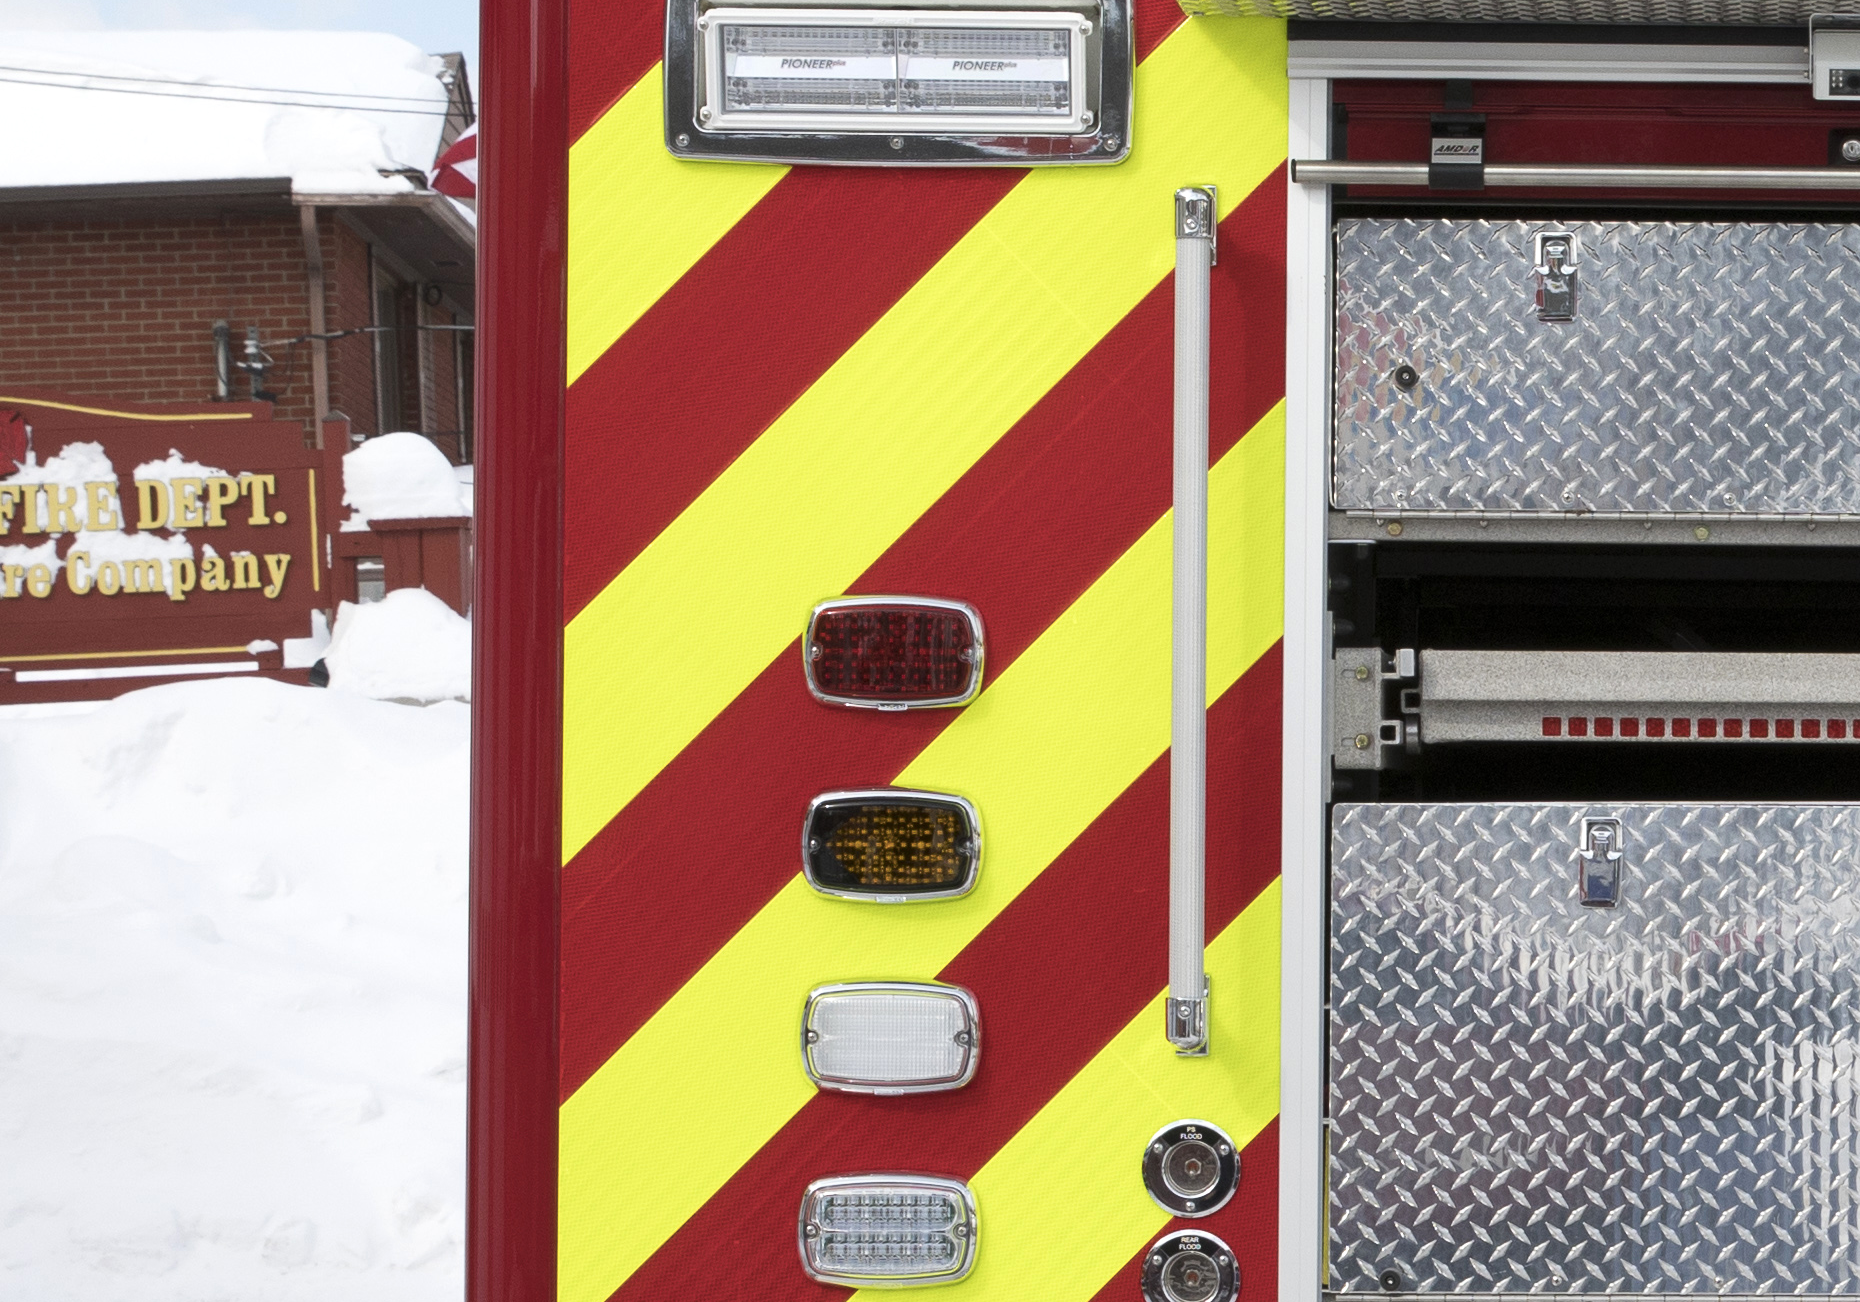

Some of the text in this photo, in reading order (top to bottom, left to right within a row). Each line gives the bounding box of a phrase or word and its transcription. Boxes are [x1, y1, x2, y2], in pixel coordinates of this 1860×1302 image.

[0, 474, 287, 535] FIRE DEPT.
[66, 550, 291, 601] Company
